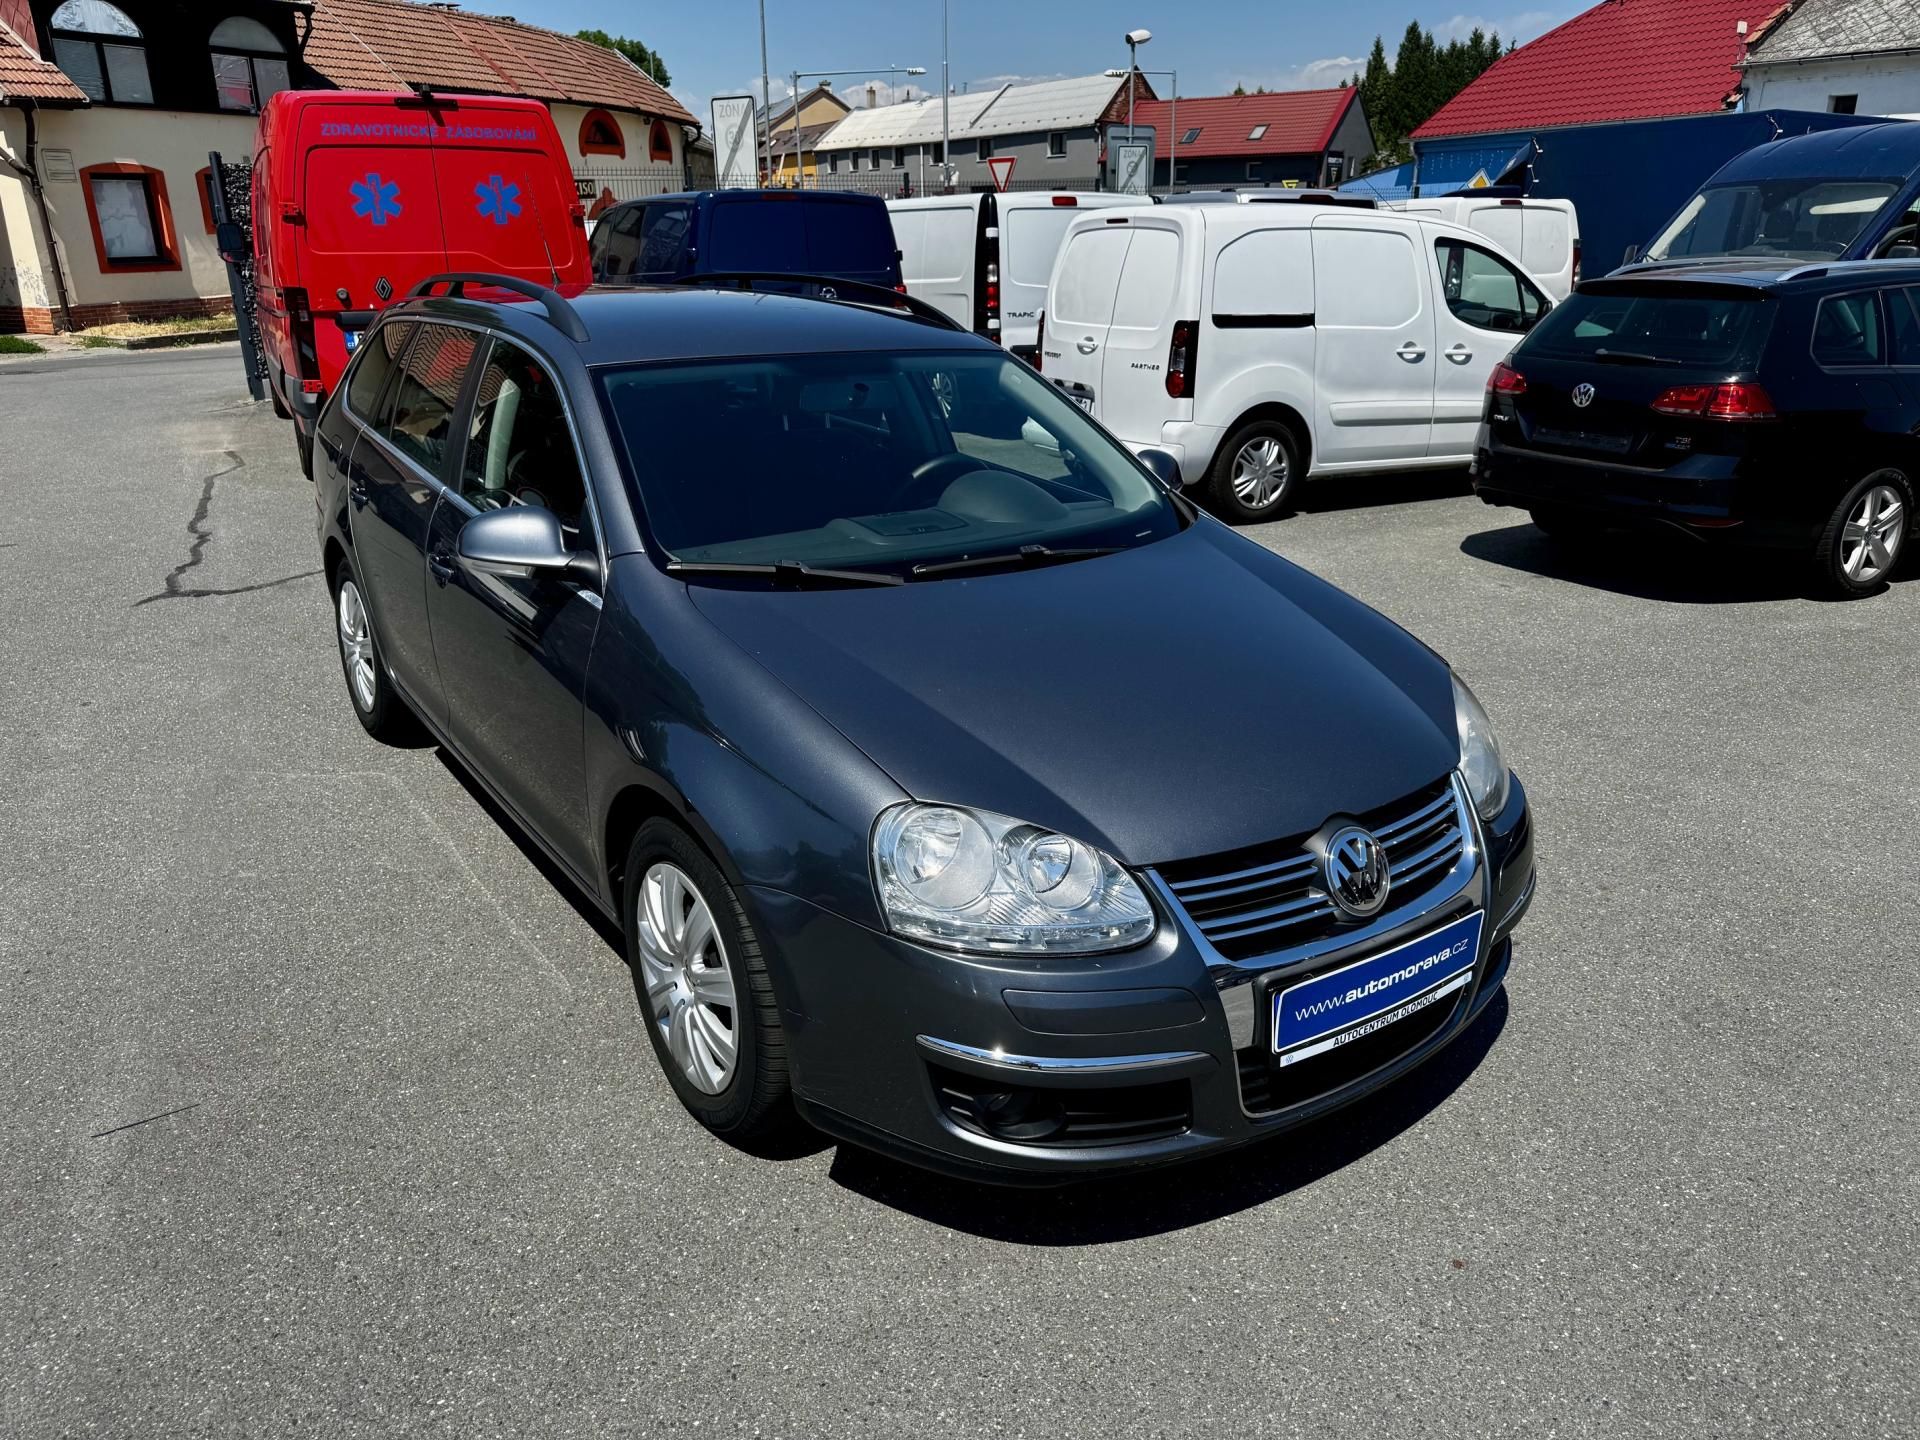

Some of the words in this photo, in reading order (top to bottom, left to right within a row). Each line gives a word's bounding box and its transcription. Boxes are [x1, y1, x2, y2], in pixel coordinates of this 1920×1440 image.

[445, 124, 537, 140] ZÁSOBOVÁNÍ
[1131, 362, 1160, 371] PARTNER
[1295, 938, 1469, 1021] www.automorava.cz
[1333, 1010, 1400, 1048] AUTOCENTRUM
[1400, 991, 1438, 1017] OLOMOUC
